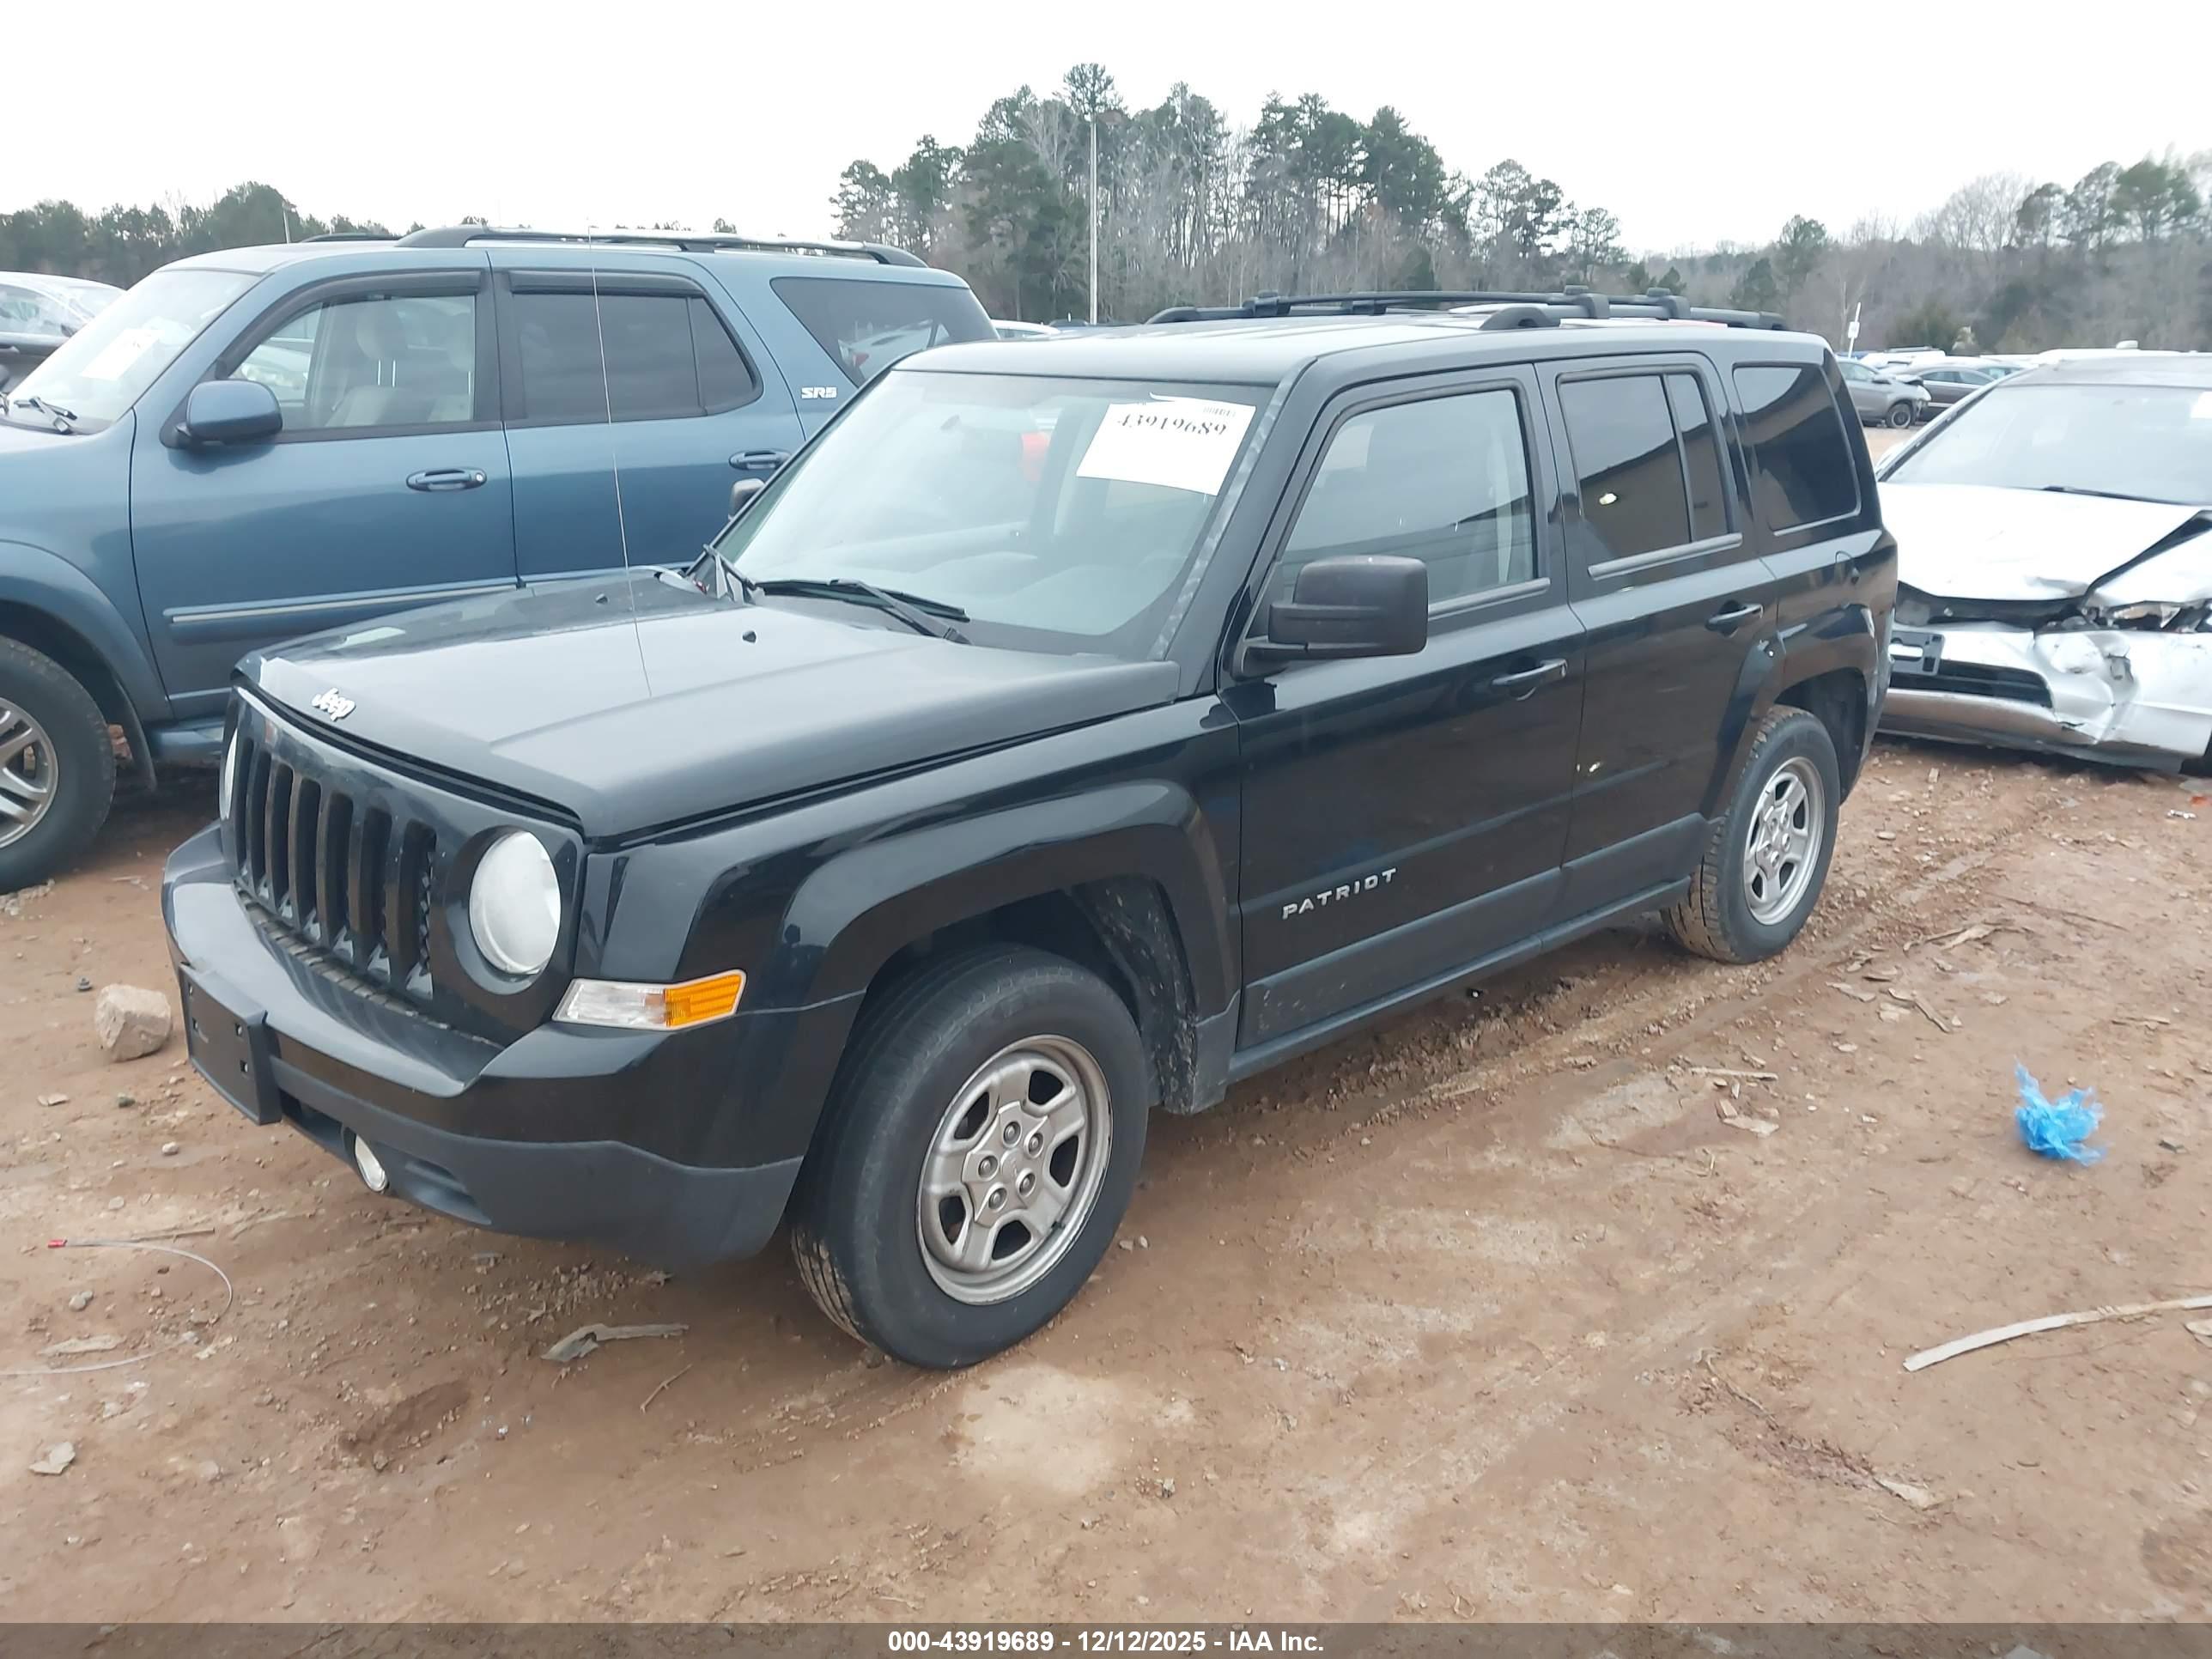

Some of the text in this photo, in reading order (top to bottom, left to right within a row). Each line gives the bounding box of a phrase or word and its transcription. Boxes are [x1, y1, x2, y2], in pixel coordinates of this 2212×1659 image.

[1117, 413, 1228, 436] 43919689
[312, 687, 356, 722] Jeep
[1282, 867, 1397, 921] PATRIOT
